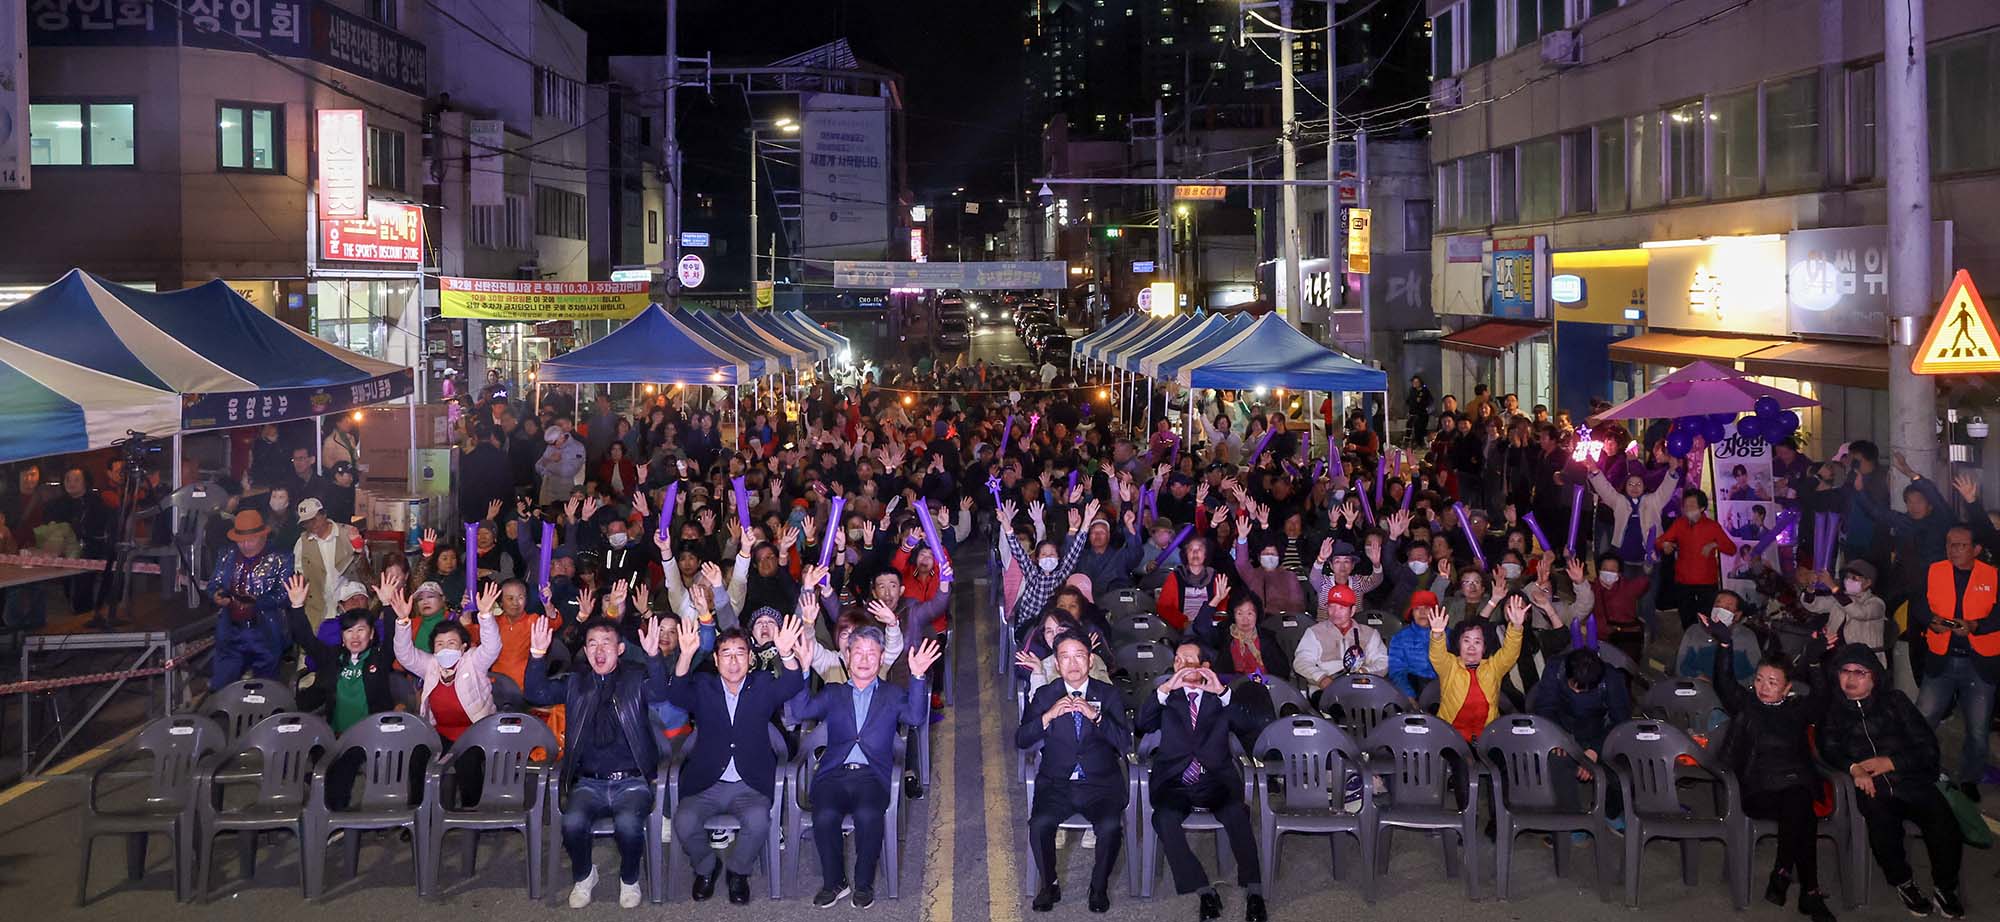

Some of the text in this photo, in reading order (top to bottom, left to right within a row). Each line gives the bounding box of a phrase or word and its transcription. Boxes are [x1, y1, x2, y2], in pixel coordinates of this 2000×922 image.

[188, 0, 300, 43] 상인회
[328, 15, 398, 79] 신탄진전통시장
[343, 243, 355, 257] THE
[379, 245, 403, 259] DISCOUNT
[404, 247, 419, 260] STORE
[449, 280, 472, 290] 제2회
[474, 281, 532, 293] 신탄진전통시장
[544, 283, 594, 293] 축제(10.30.)
